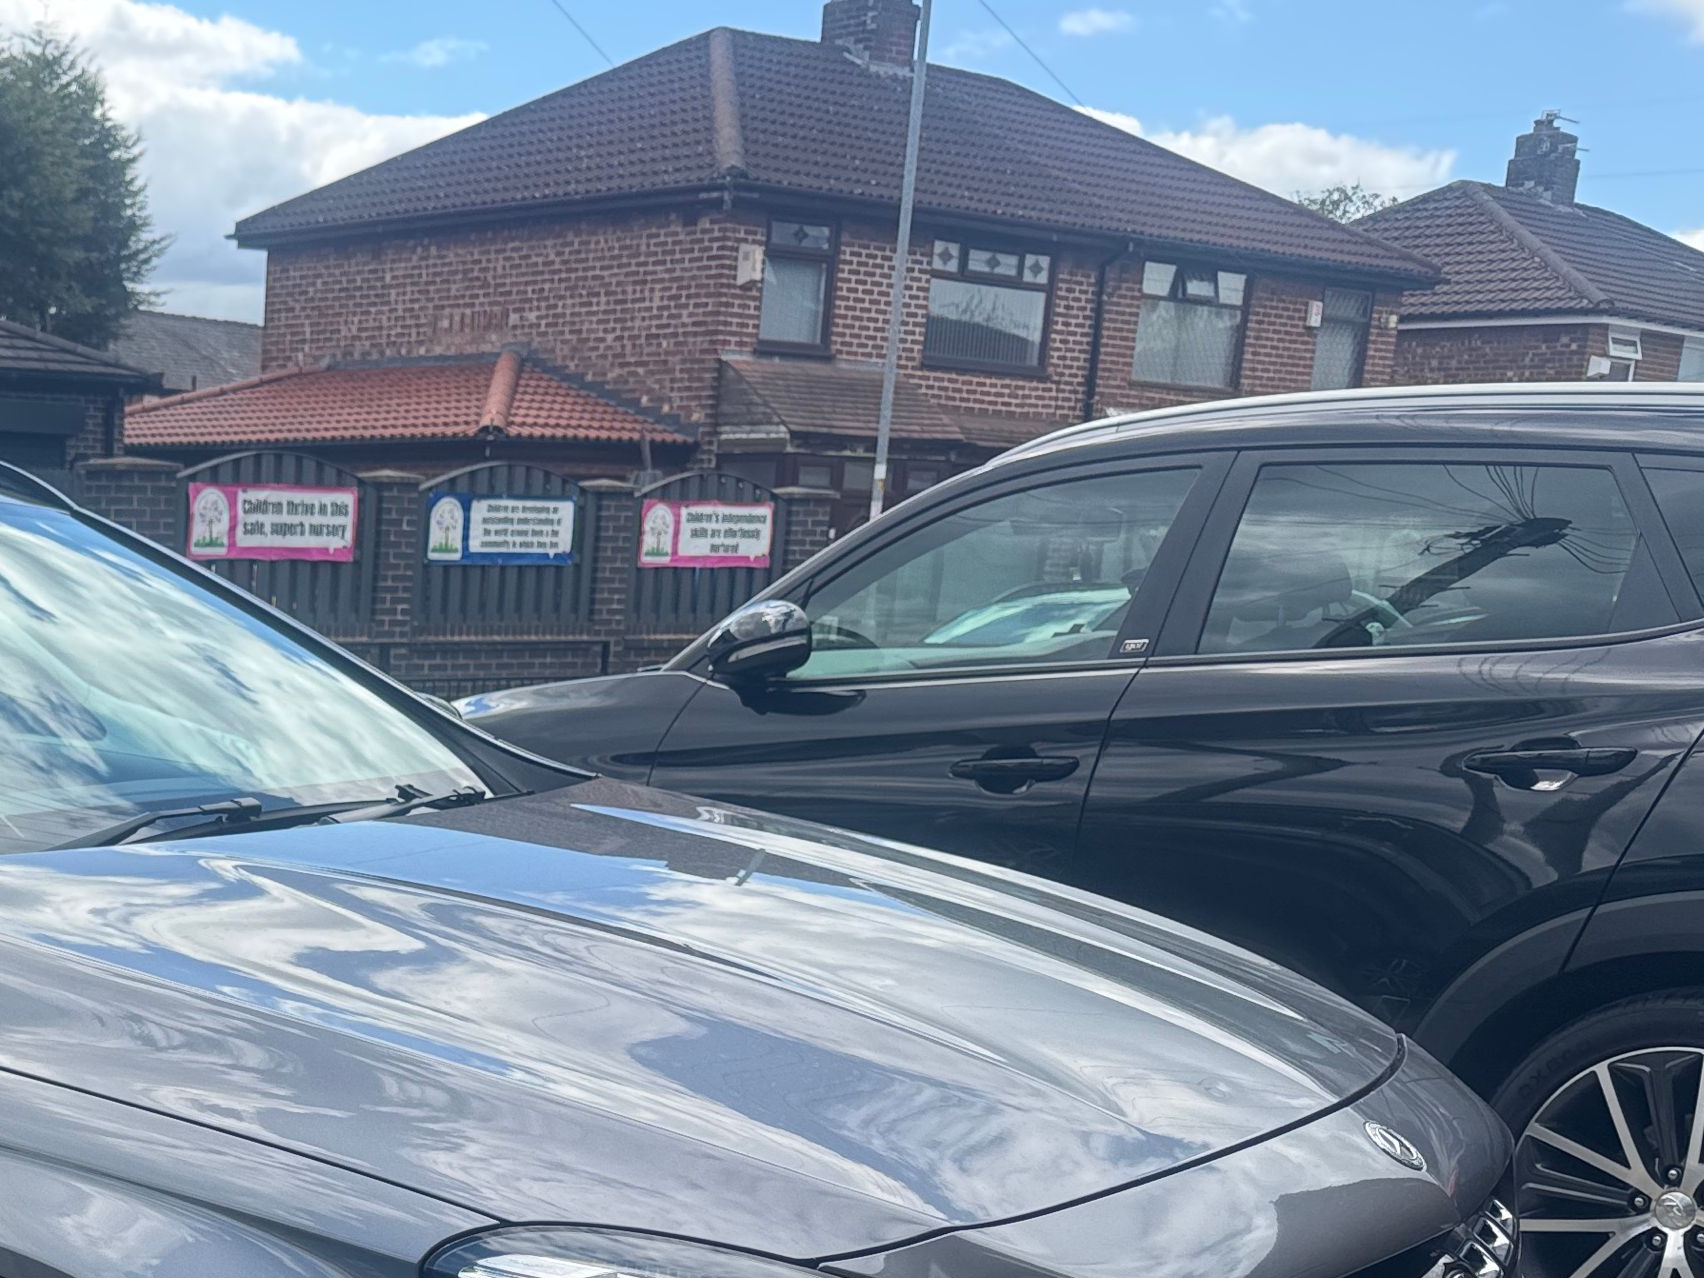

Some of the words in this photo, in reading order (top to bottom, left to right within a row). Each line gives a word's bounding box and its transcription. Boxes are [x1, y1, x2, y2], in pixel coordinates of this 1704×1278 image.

[242, 498, 284, 516] Children
[286, 499, 315, 517] thrive
[317, 500, 328, 517] in
[330, 501, 349, 518] this
[270, 521, 306, 538] superb
[308, 523, 347, 540] nursery
